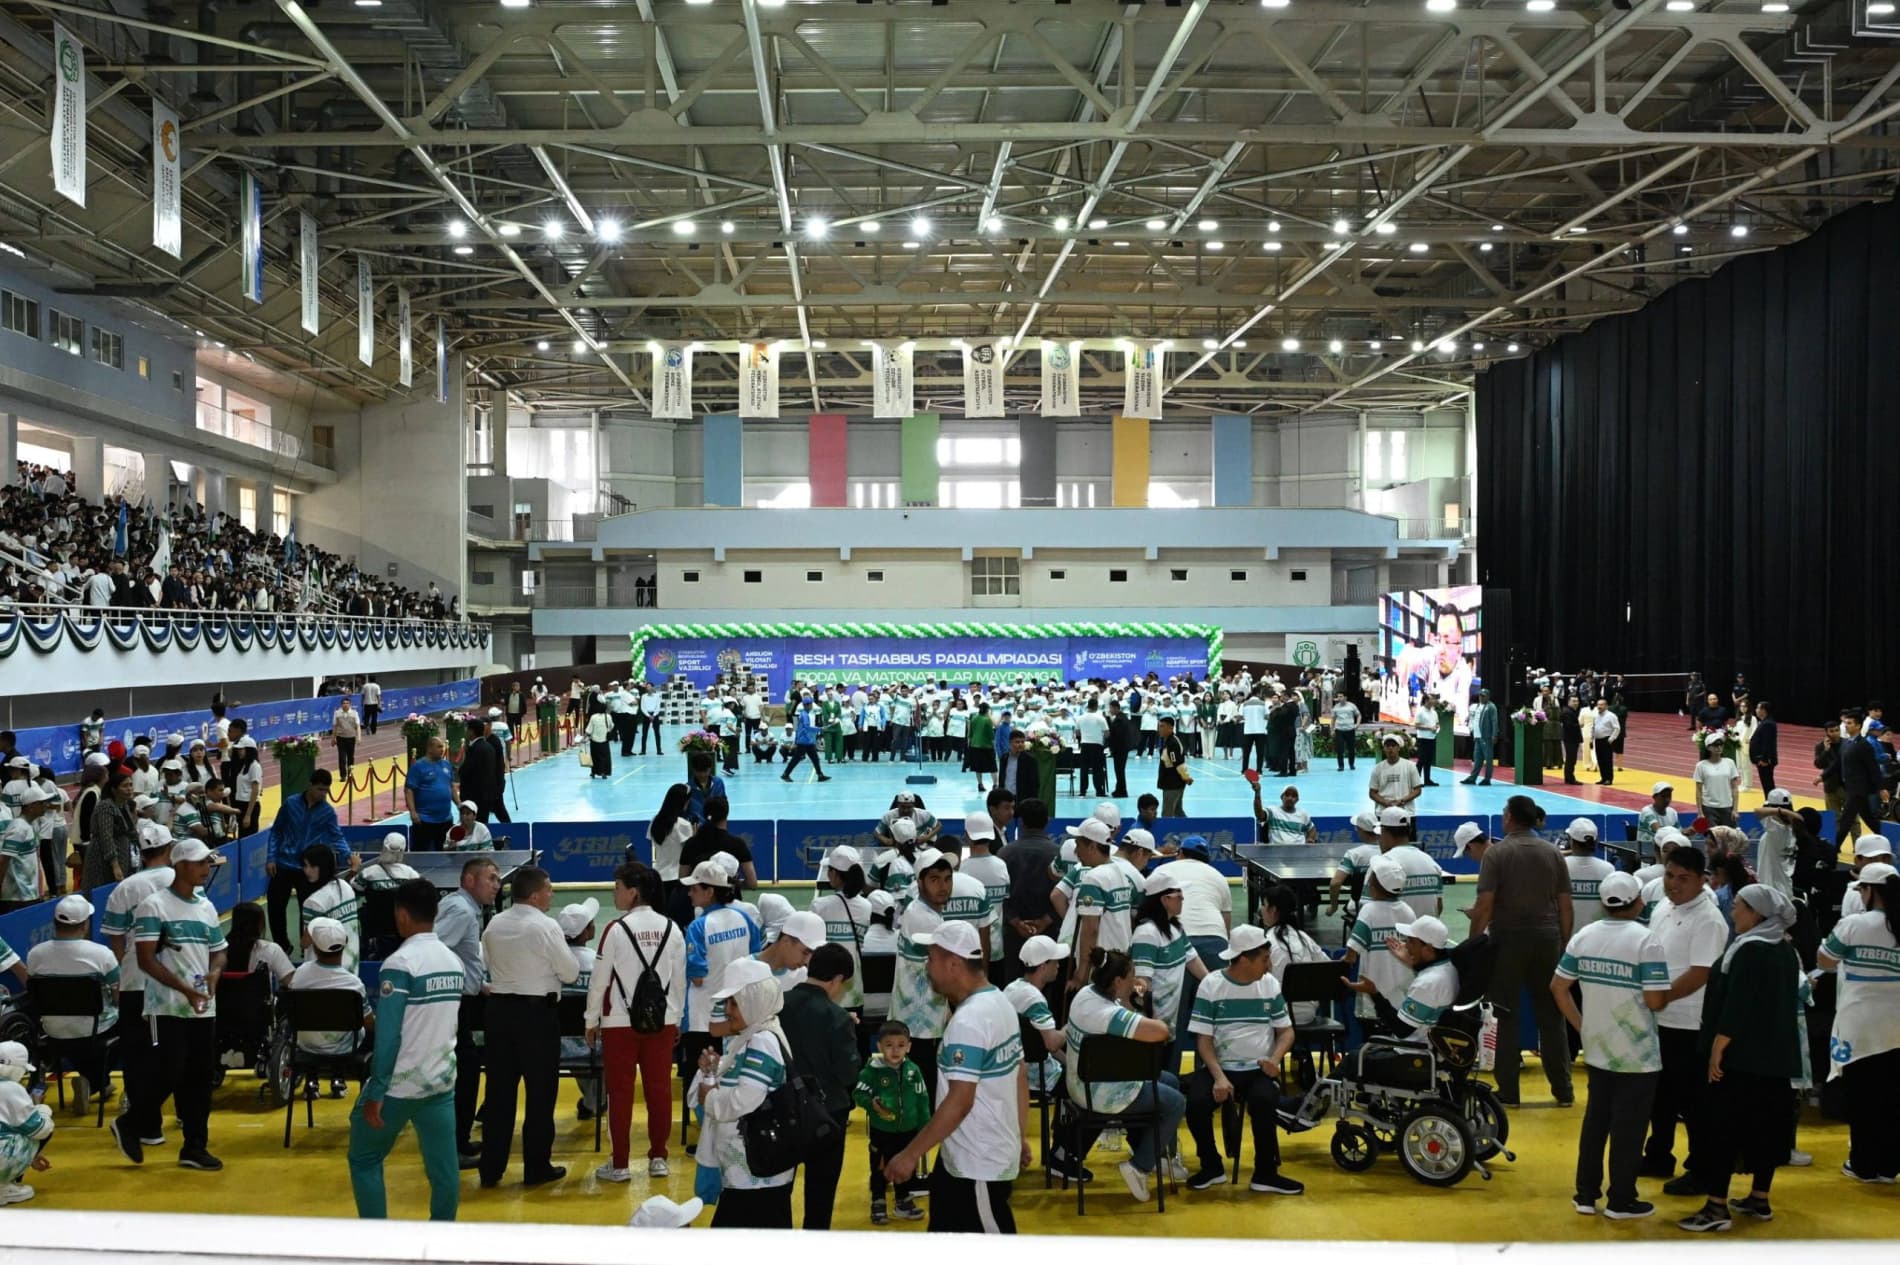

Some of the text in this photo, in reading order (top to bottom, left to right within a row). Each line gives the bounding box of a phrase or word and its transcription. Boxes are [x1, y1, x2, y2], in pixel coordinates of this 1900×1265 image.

[793, 654, 1062, 665] BESH TASHABBUS PARALIMPIADASI
[795, 671, 837, 682] IRODA
[842, 671, 860, 681] VA
